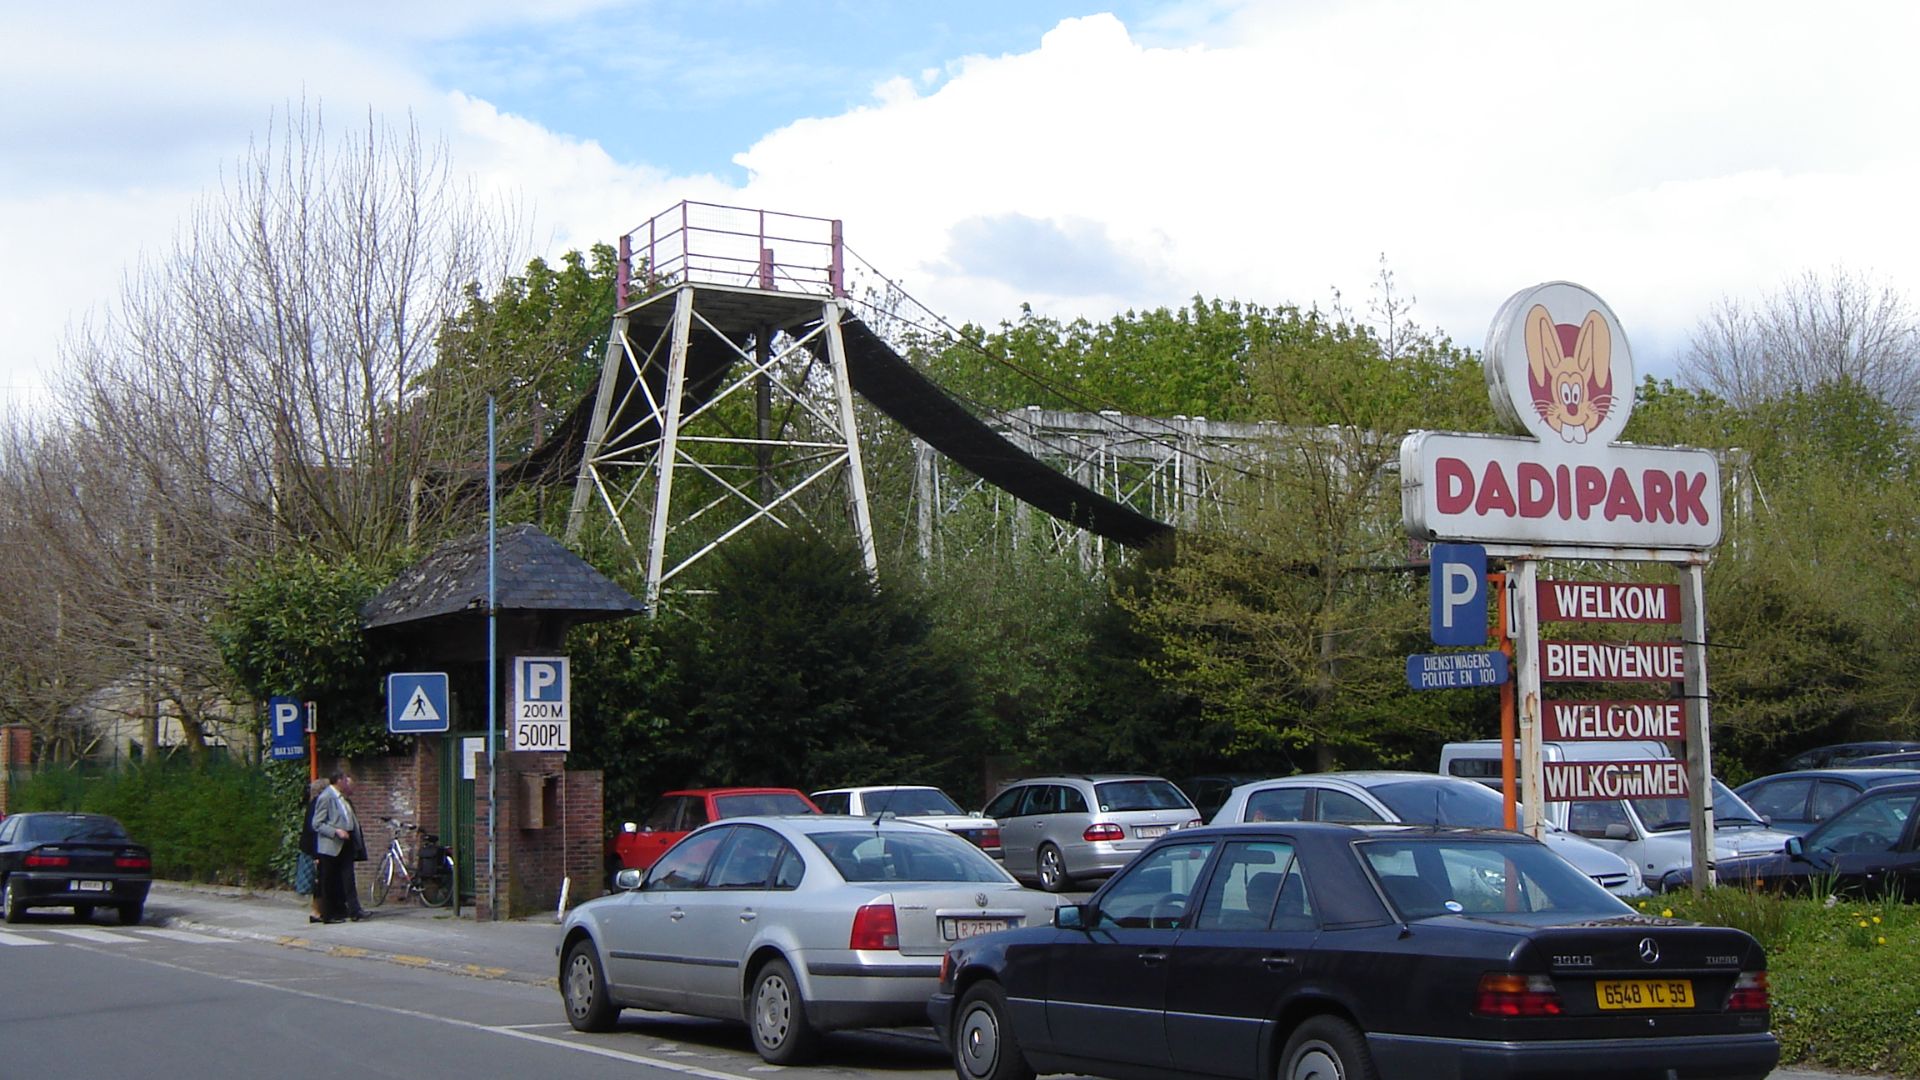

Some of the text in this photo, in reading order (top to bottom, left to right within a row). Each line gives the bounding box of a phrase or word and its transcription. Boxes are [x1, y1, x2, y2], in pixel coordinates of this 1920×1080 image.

[1435, 457, 1709, 526] DADIPARK
[1442, 562, 1478, 628] P
[1554, 584, 1666, 620] WELKOM
[1421, 668, 1496, 687] POLITIE EN 100
[1423, 653, 1491, 671] DIENSTWAGENS
[1547, 644, 1685, 678] BIENVENUE
[530, 663, 556, 699] P
[275, 703, 298, 737] P
[523, 704, 563, 718] 200 M
[1554, 704, 1681, 738] WELCOME
[519, 724, 567, 746] 500PL
[1604, 983, 1686, 1005] 6548 YC 59
